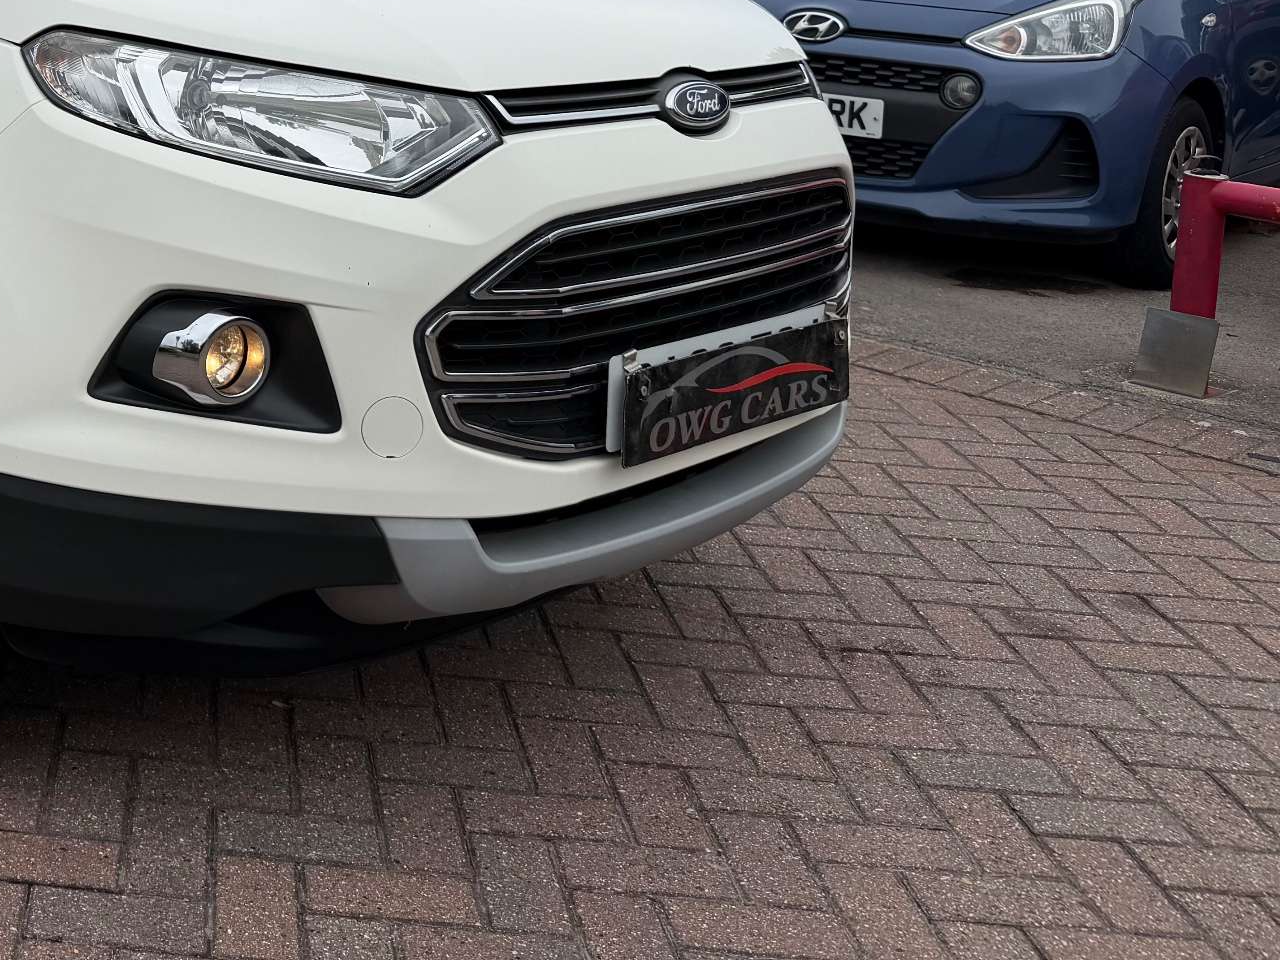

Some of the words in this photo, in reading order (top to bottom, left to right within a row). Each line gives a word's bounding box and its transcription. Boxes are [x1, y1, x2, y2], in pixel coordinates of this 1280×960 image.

[687, 89, 720, 115] Ford
[650, 399, 732, 453] OWG
[741, 374, 828, 424] CARS
